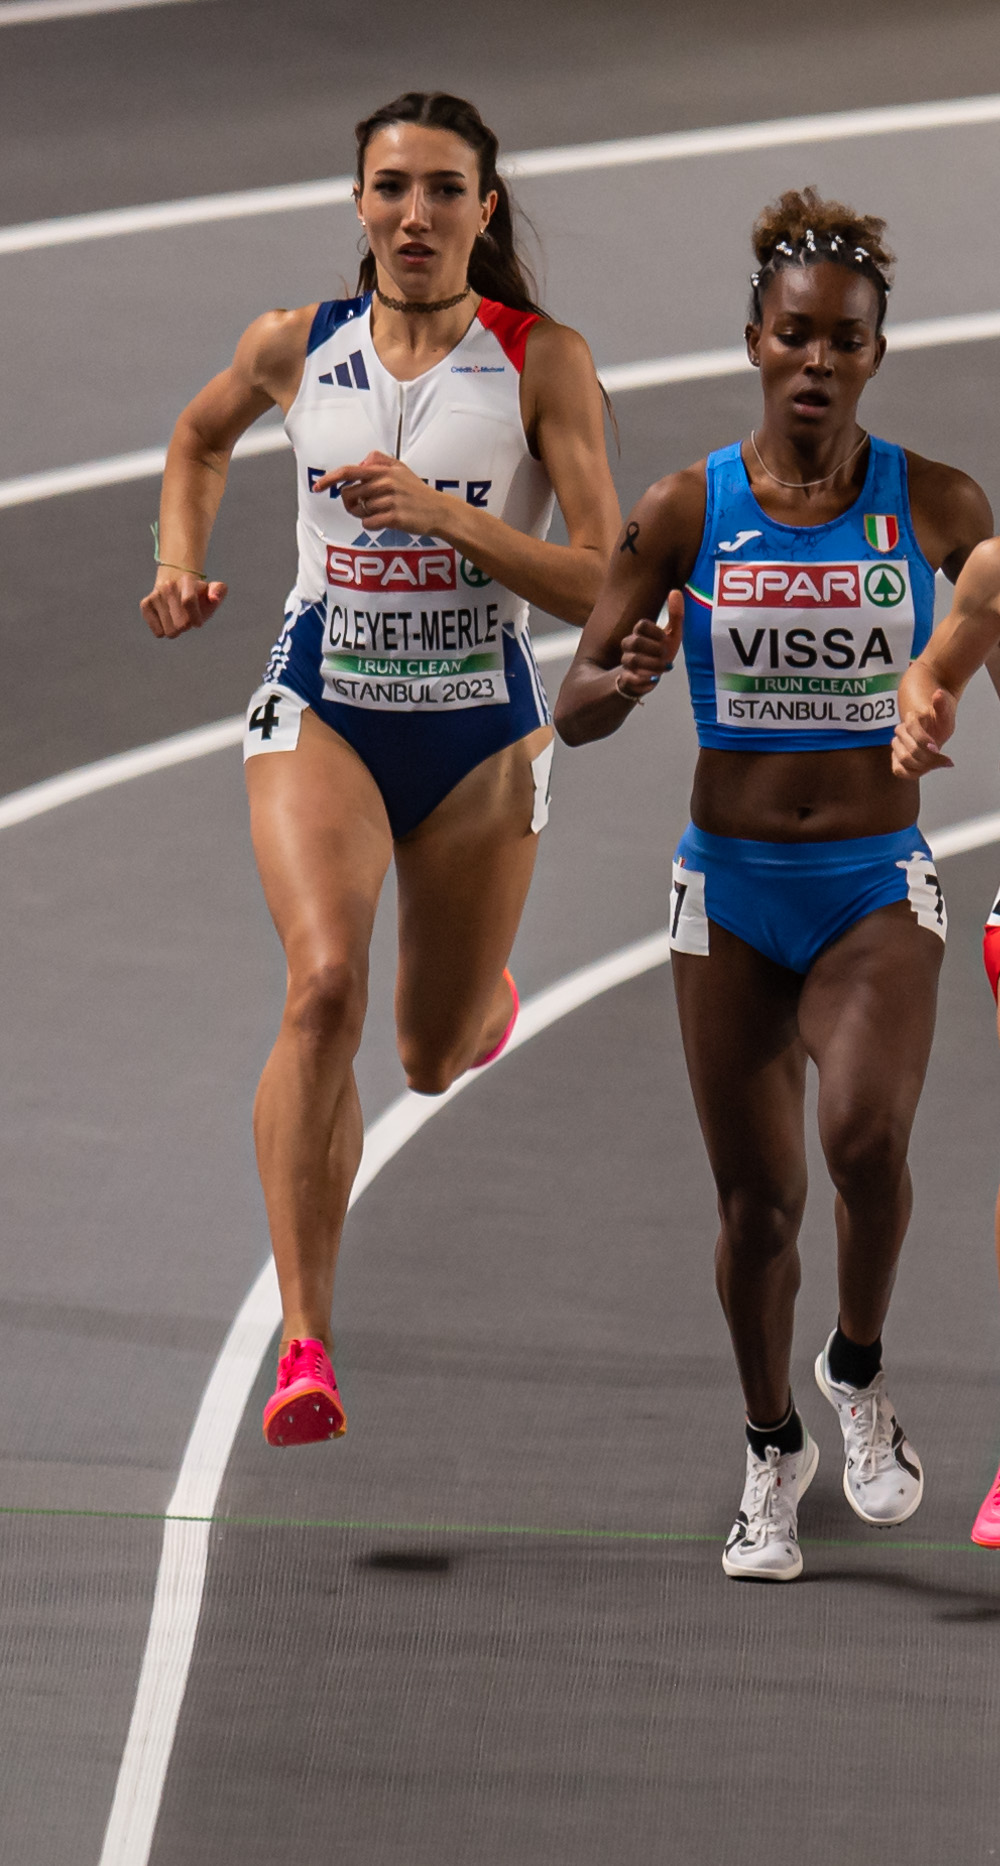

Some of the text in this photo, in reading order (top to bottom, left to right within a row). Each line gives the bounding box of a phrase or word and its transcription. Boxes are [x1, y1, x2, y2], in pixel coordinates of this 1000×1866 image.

[330, 552, 453, 587] SPAR
[722, 570, 857, 602] SPAR
[329, 603, 498, 651] CLEYET-MERLE
[728, 627, 894, 669] VISSA
[365, 660, 401, 675] RUN
[406, 660, 463, 675] CLEAN
[332, 678, 495, 703] ISTANBUL 2023
[765, 679, 803, 691] RUN
[249, 694, 282, 740] 4
[728, 698, 896, 722] ISTANBUL 2023
